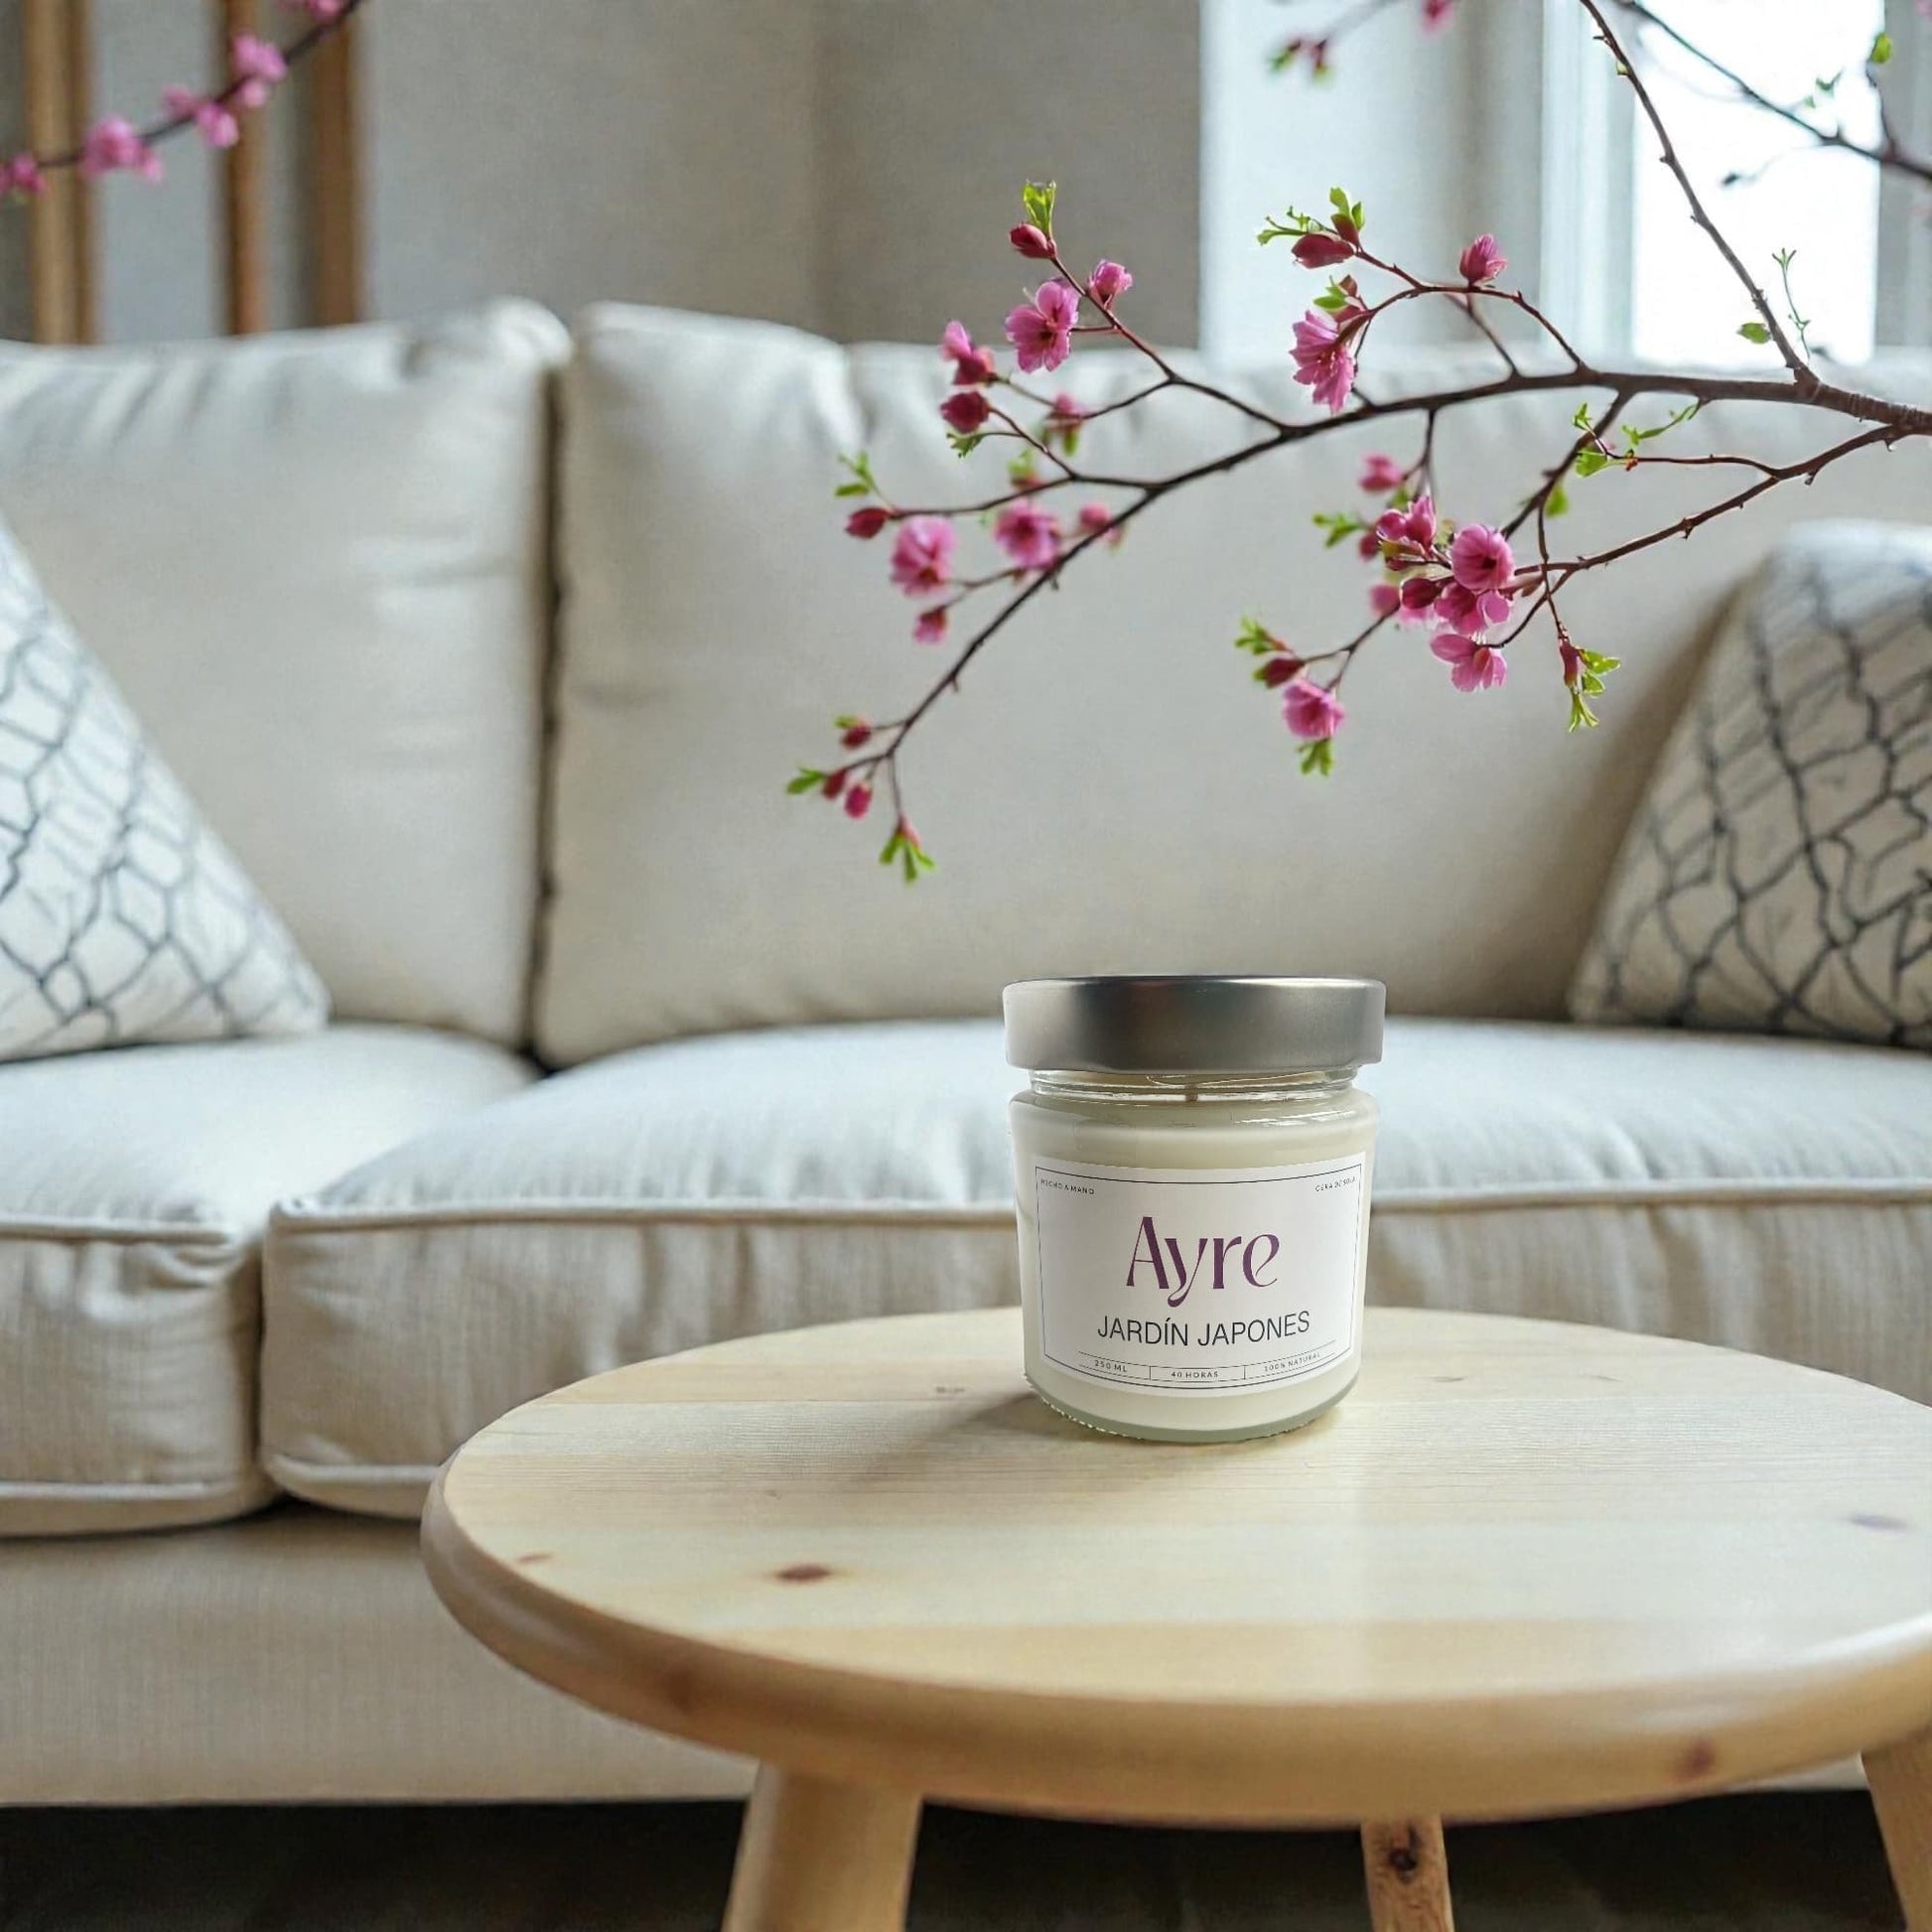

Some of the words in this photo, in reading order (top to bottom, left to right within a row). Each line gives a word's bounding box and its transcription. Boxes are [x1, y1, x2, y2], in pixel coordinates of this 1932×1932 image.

[1070, 1185, 1094, 1194] MANO
[1126, 1216, 1280, 1308] Ayre
[1097, 1315, 1188, 1346] JARDÍN
[1197, 1311, 1311, 1346] JAPONES
[1094, 1359, 1111, 1370] 250
[1288, 1352, 1320, 1367] NATURAL
